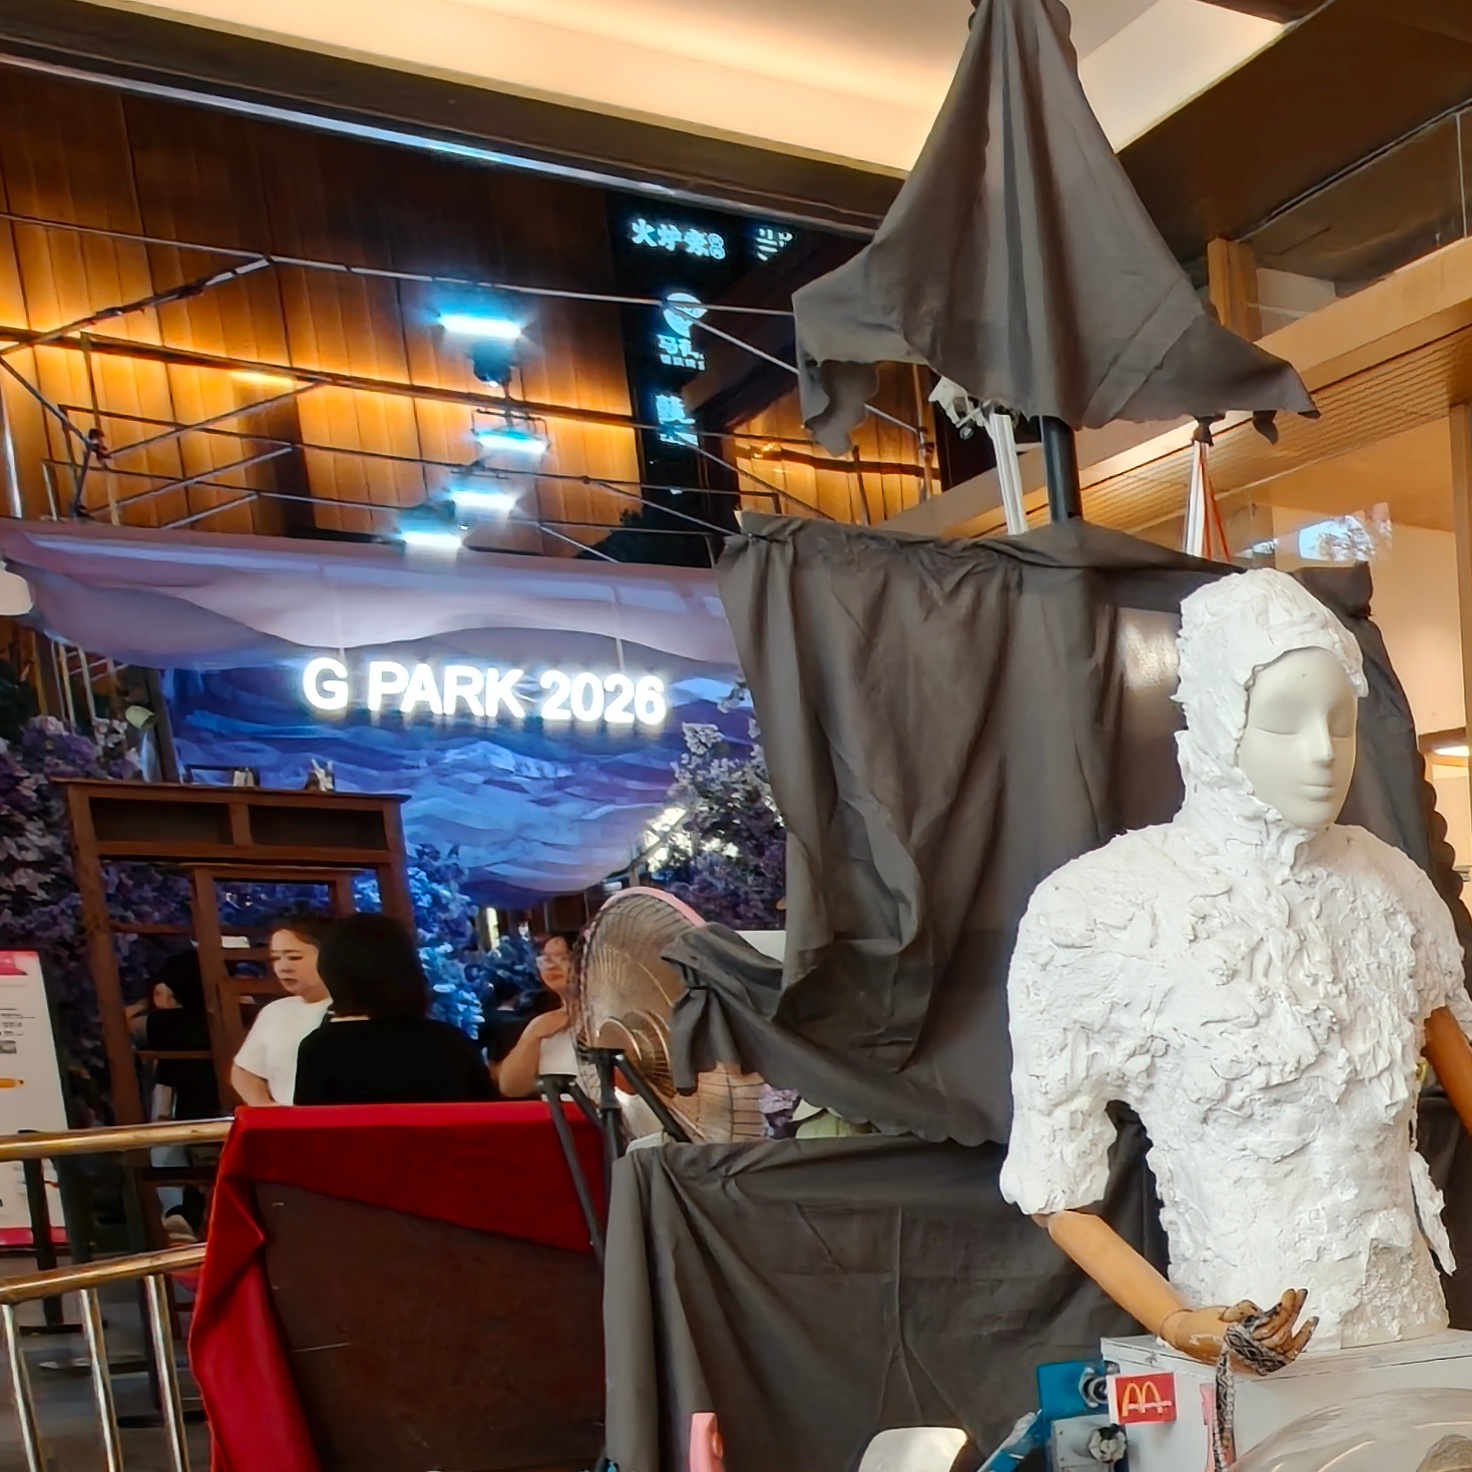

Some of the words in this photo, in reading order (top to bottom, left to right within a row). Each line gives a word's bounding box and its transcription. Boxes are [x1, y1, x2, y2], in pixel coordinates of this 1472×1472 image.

[302, 656, 350, 711] G
[367, 660, 526, 719] PARK
[539, 669, 667, 725] 2026
